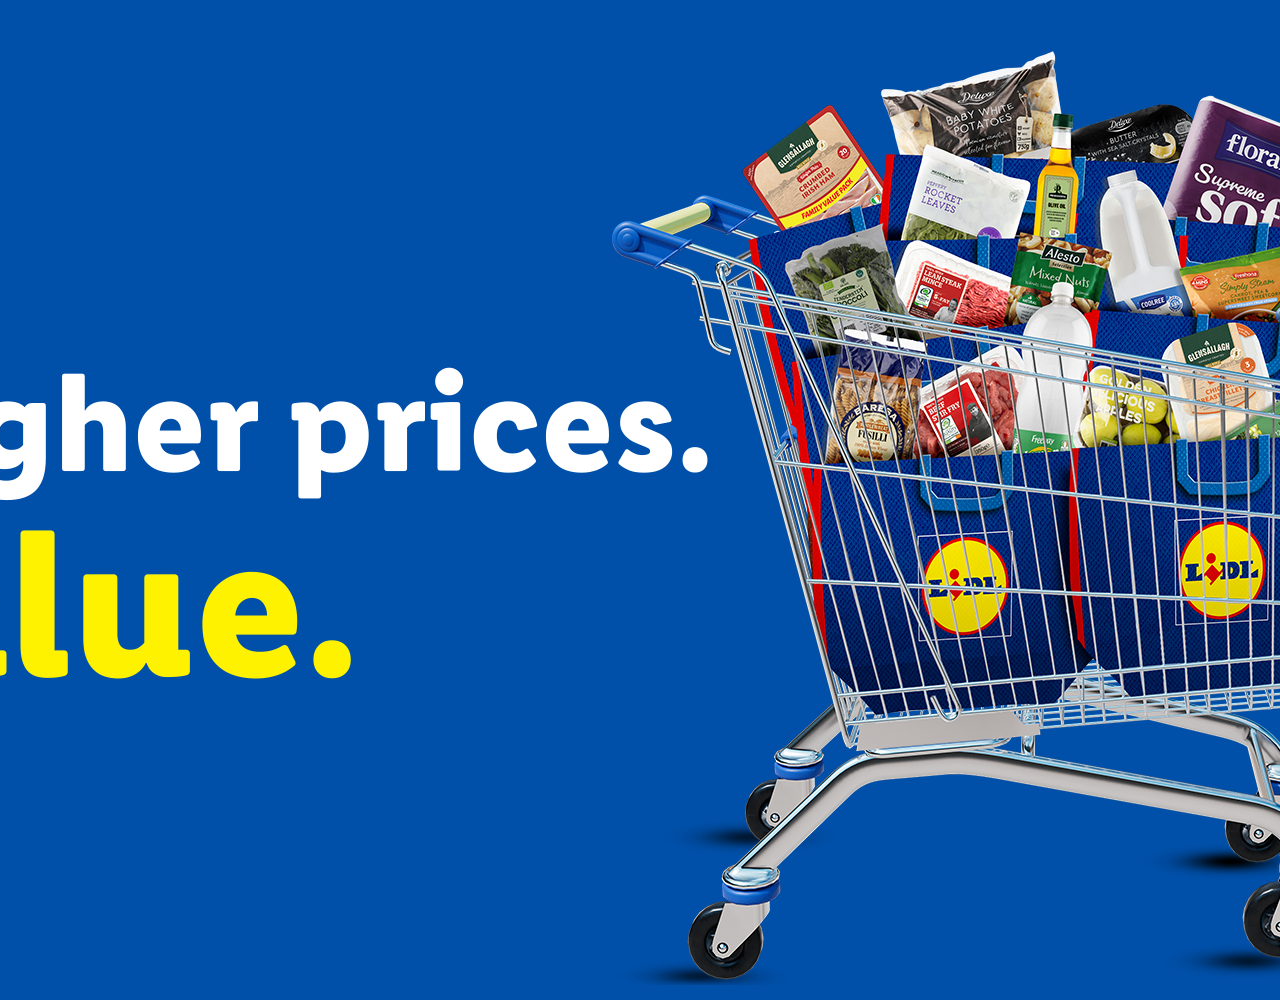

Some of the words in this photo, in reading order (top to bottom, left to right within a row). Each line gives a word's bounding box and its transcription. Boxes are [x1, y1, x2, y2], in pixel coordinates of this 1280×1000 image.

[960, 91, 995, 103] Deluxe
[946, 110, 974, 126] BABY
[978, 103, 1014, 117] WHITE
[953, 113, 1012, 135] POTATOES
[1109, 131, 1137, 145] BUTTER
[1120, 141, 1132, 149] SALT
[1132, 133, 1159, 145] CRYSTALS
[777, 137, 816, 169] GLENSALLAGH
[839, 147, 848, 156] 20
[798, 166, 831, 193] CRUMBED
[802, 180, 820, 199] IRISH
[819, 172, 836, 188] HAM
[1194, 163, 1265, 202] Supreme
[801, 204, 824, 219] FAMILY
[821, 189, 841, 209] VALUE
[839, 177, 853, 194] PACK
[921, 195, 957, 214] LEAVES
[924, 186, 963, 205] ROCKET
[1045, 248, 1080, 263] Alesto
[922, 276, 943, 288] MINCE
[924, 270, 942, 281] LEAN
[941, 277, 962, 289] STEAK
[1029, 266, 1062, 282] Mixed
[1065, 274, 1090, 288] Nuts
[1234, 271, 1257, 279] Freshona
[1220, 281, 1248, 294] Simply
[1249, 279, 1275, 289] Steam
[1187, 342, 1231, 362] GLENSALLAGH
[1205, 382, 1235, 395] CHICEN
[1222, 386, 1246, 396] ILLETS
[854, 404, 897, 422] BARESA
[947, 401, 960, 413] FRY
[1031, 434, 1055, 446] Freeay
